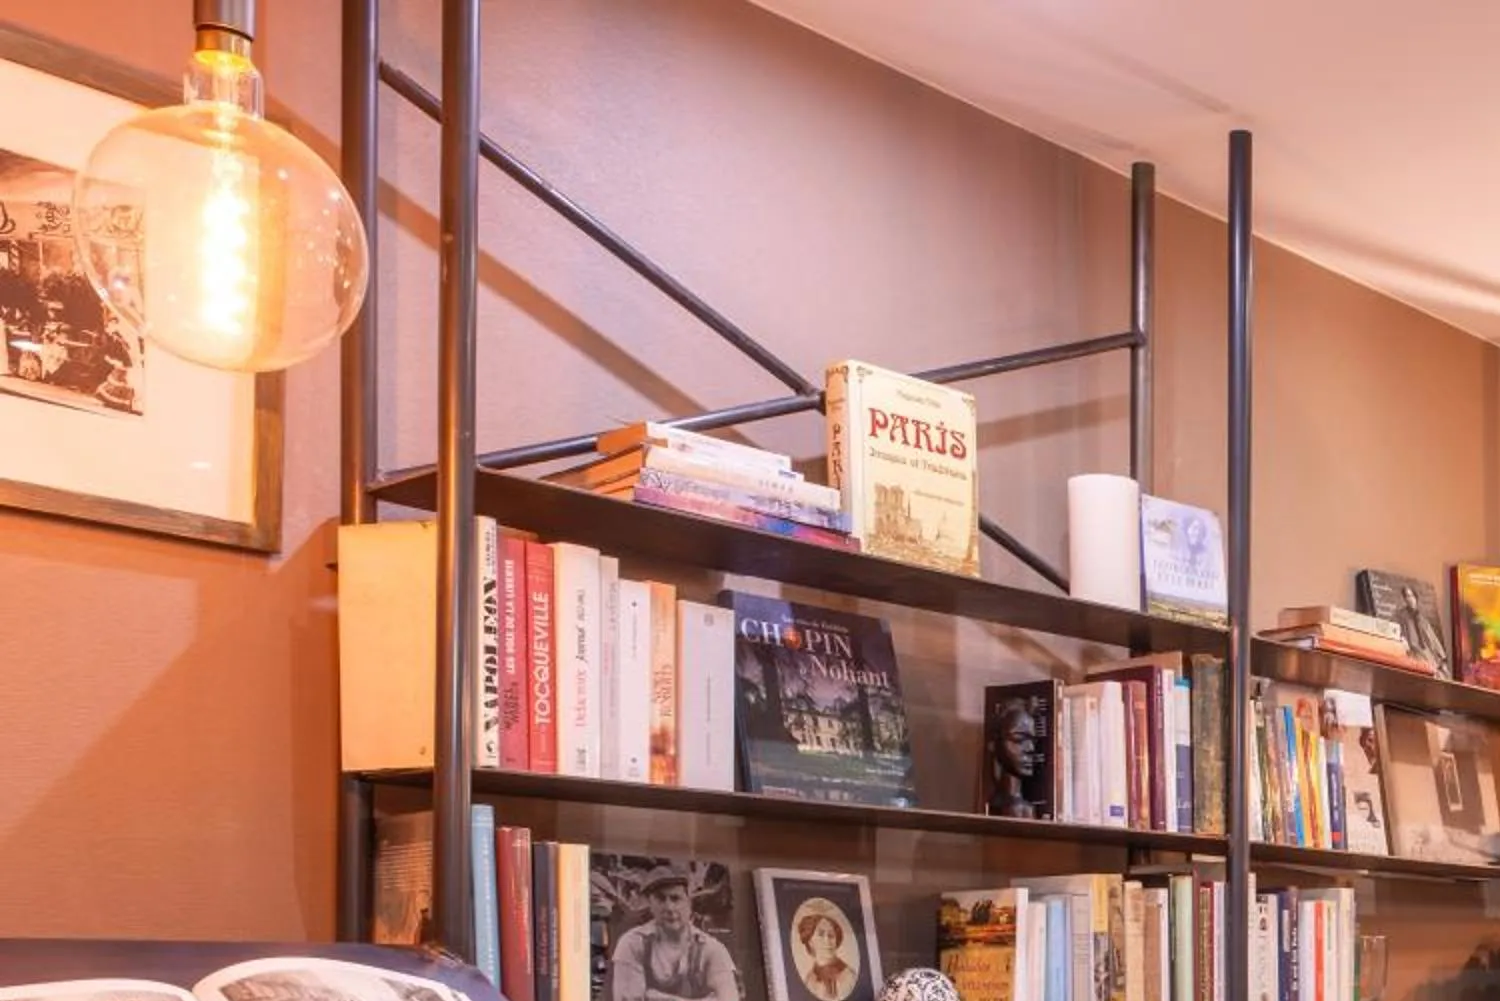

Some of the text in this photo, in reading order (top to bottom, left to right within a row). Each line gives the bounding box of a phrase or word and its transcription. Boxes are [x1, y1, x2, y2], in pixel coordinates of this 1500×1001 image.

[868, 407, 967, 460] PARIS
[533, 591, 551, 727] TOCQUEVILLE
[741, 617, 852, 658] CHOPIN
[810, 655, 890, 688] Nohant
